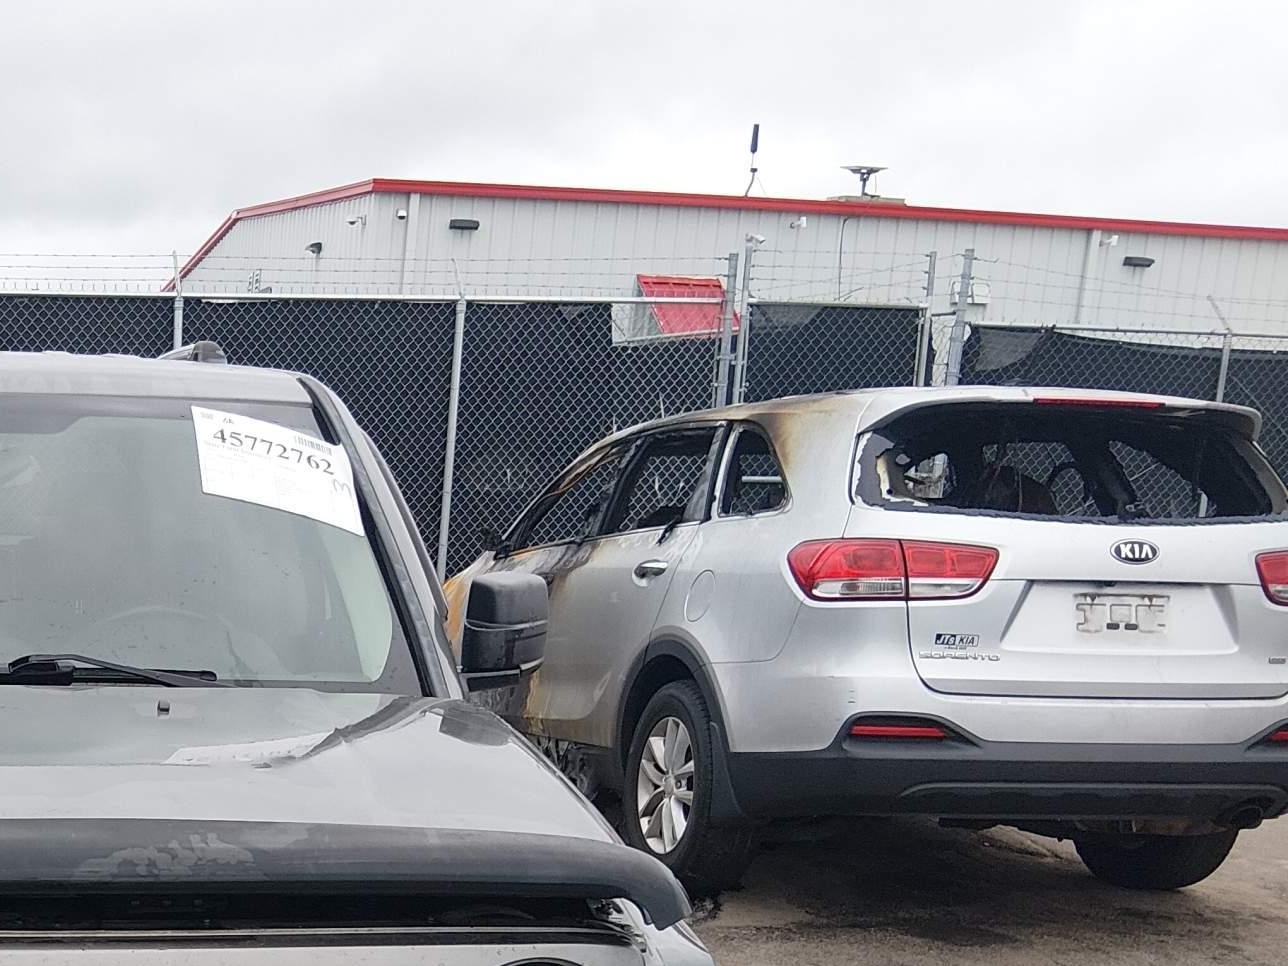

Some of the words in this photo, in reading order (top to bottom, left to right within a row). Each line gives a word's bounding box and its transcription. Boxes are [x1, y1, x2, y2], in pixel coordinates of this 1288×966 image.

[213, 429, 335, 475] 45772762
[1119, 543, 1153, 559] KIA
[957, 634, 975, 646] KIA
[918, 651, 1000, 661] SORENTO
